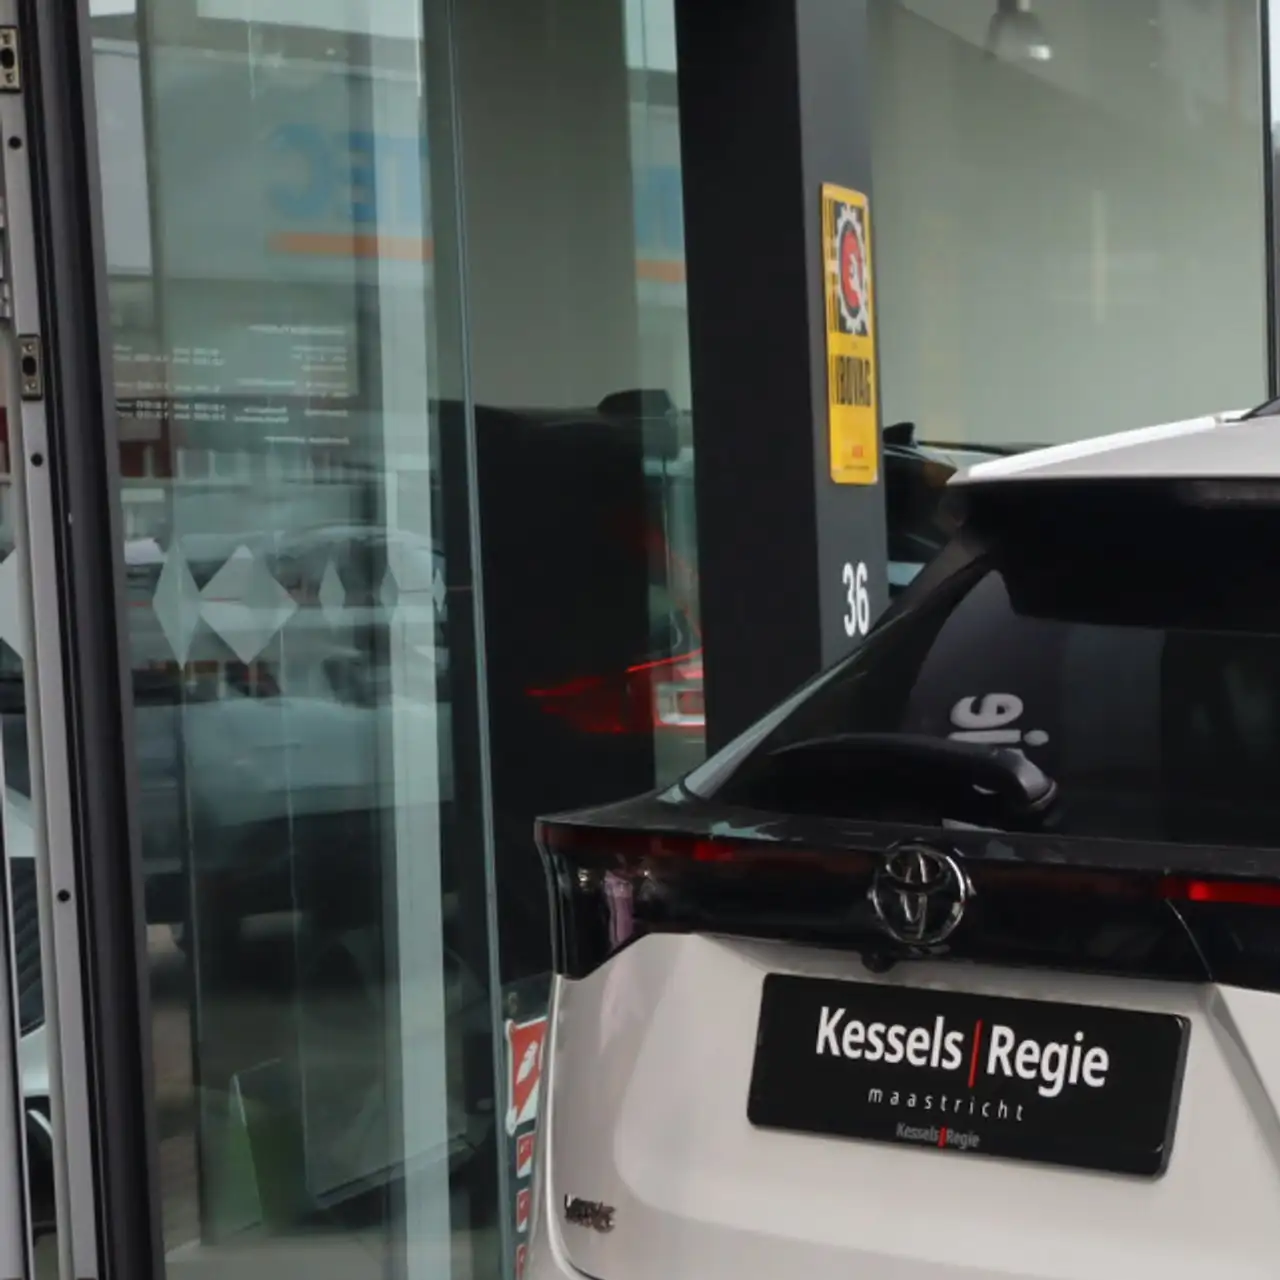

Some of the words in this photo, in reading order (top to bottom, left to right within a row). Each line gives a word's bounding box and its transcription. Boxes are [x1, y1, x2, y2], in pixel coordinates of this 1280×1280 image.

[842, 561, 870, 637] 36
[816, 1005, 965, 1071] Kessels
[986, 1023, 1109, 1098] Regie
[868, 1087, 1024, 1122] maastricht
